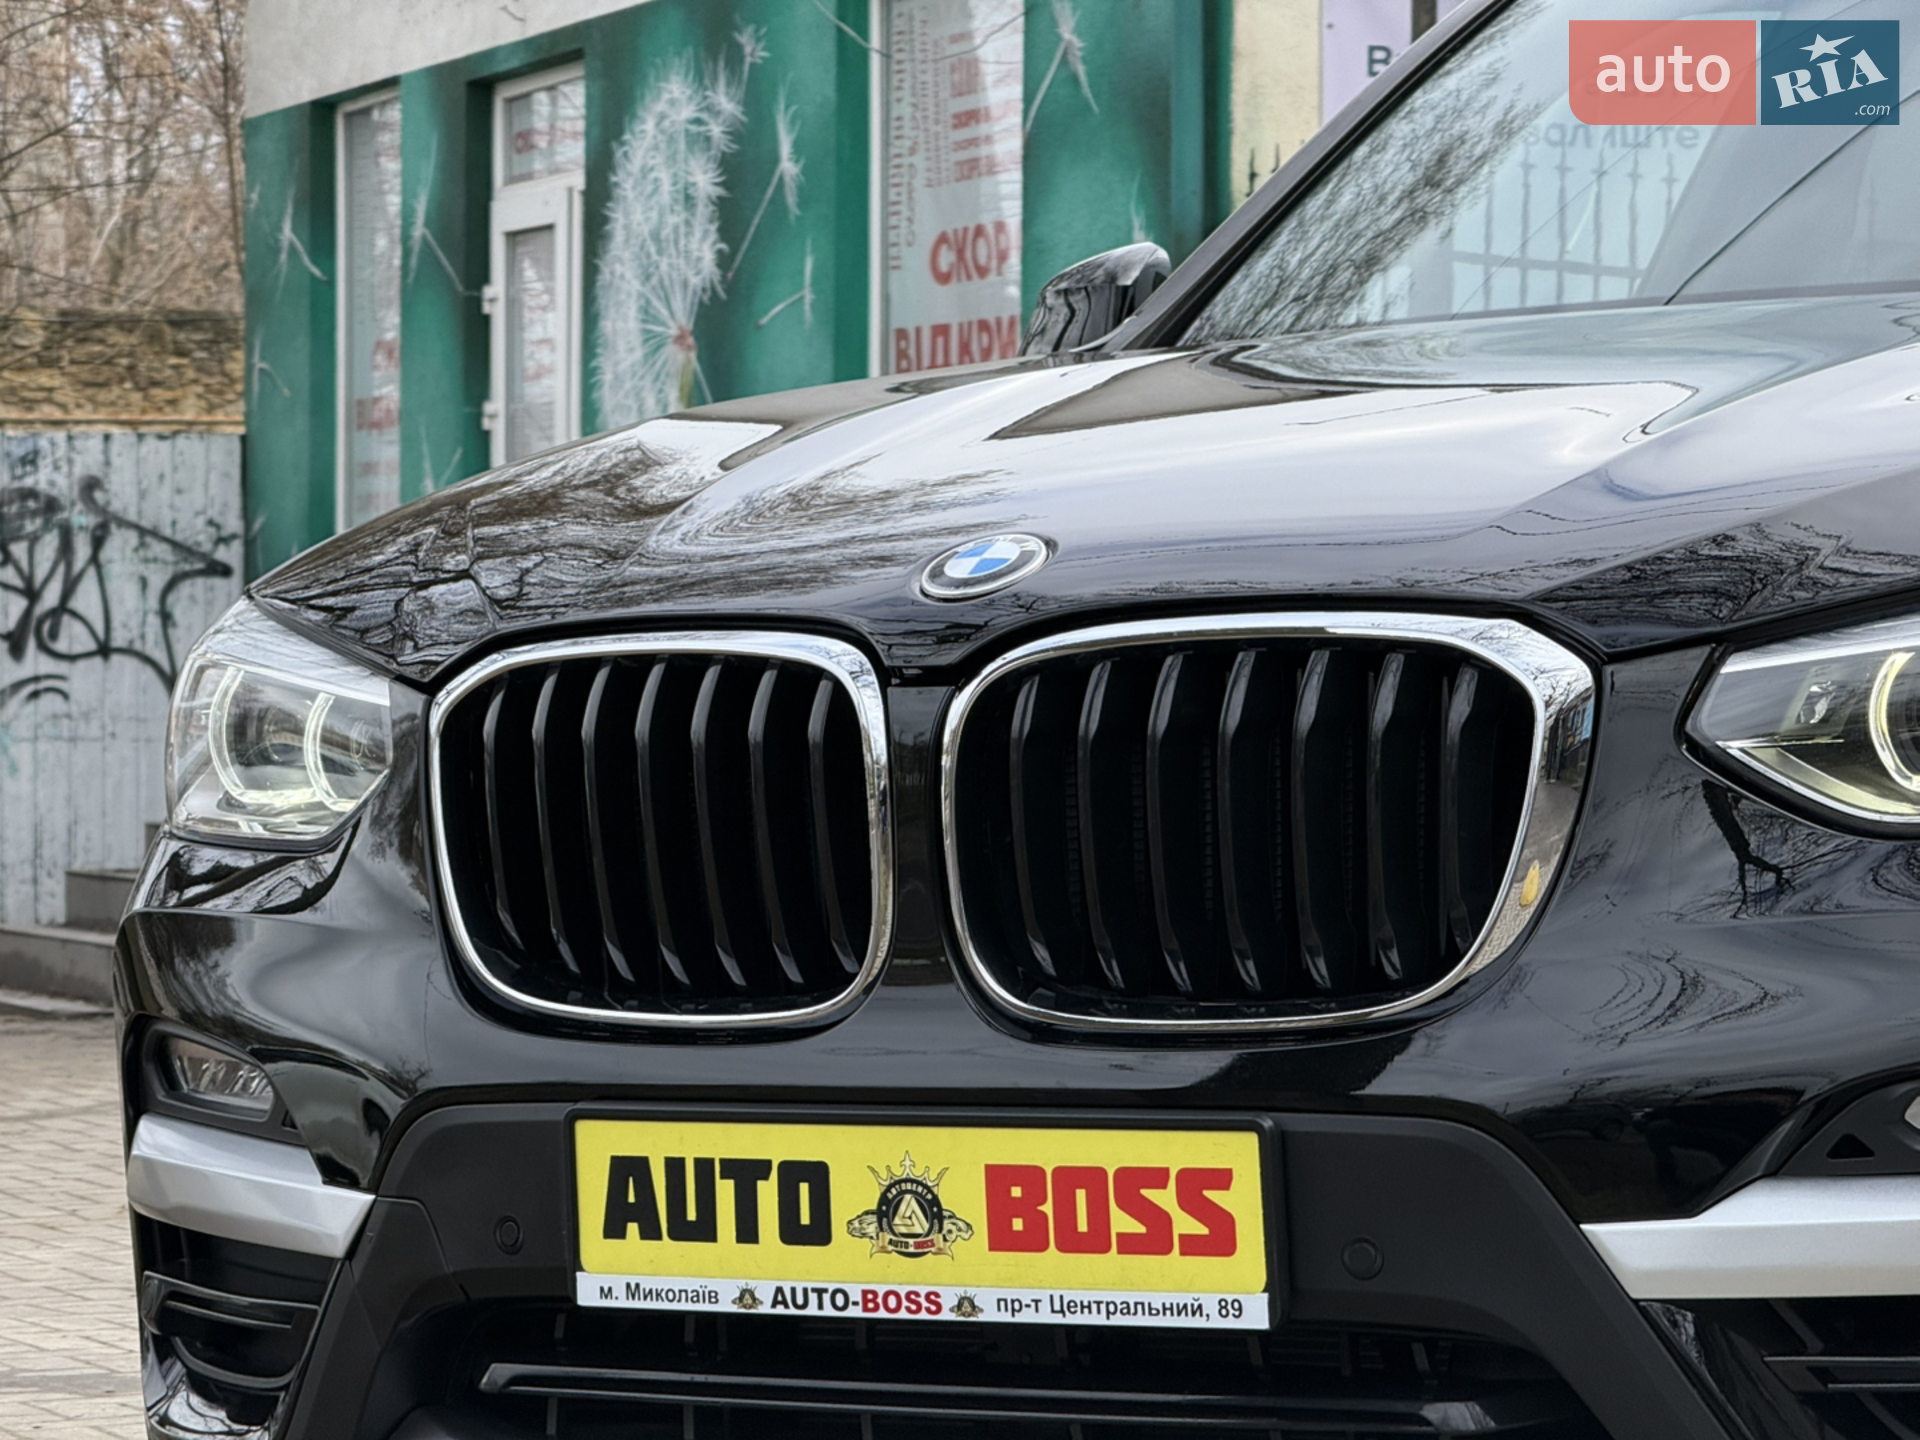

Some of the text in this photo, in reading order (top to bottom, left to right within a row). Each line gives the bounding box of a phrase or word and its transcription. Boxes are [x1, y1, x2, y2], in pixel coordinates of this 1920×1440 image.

[929, 220, 1022, 286] СКОР
[603, 1155, 1238, 1257] AUTO BOSS
[599, 1282, 720, 1305] м. Миколаїв
[770, 1286, 942, 1316] AUTO-BOSS
[996, 1294, 1244, 1321] пр-т Центральний, 89
